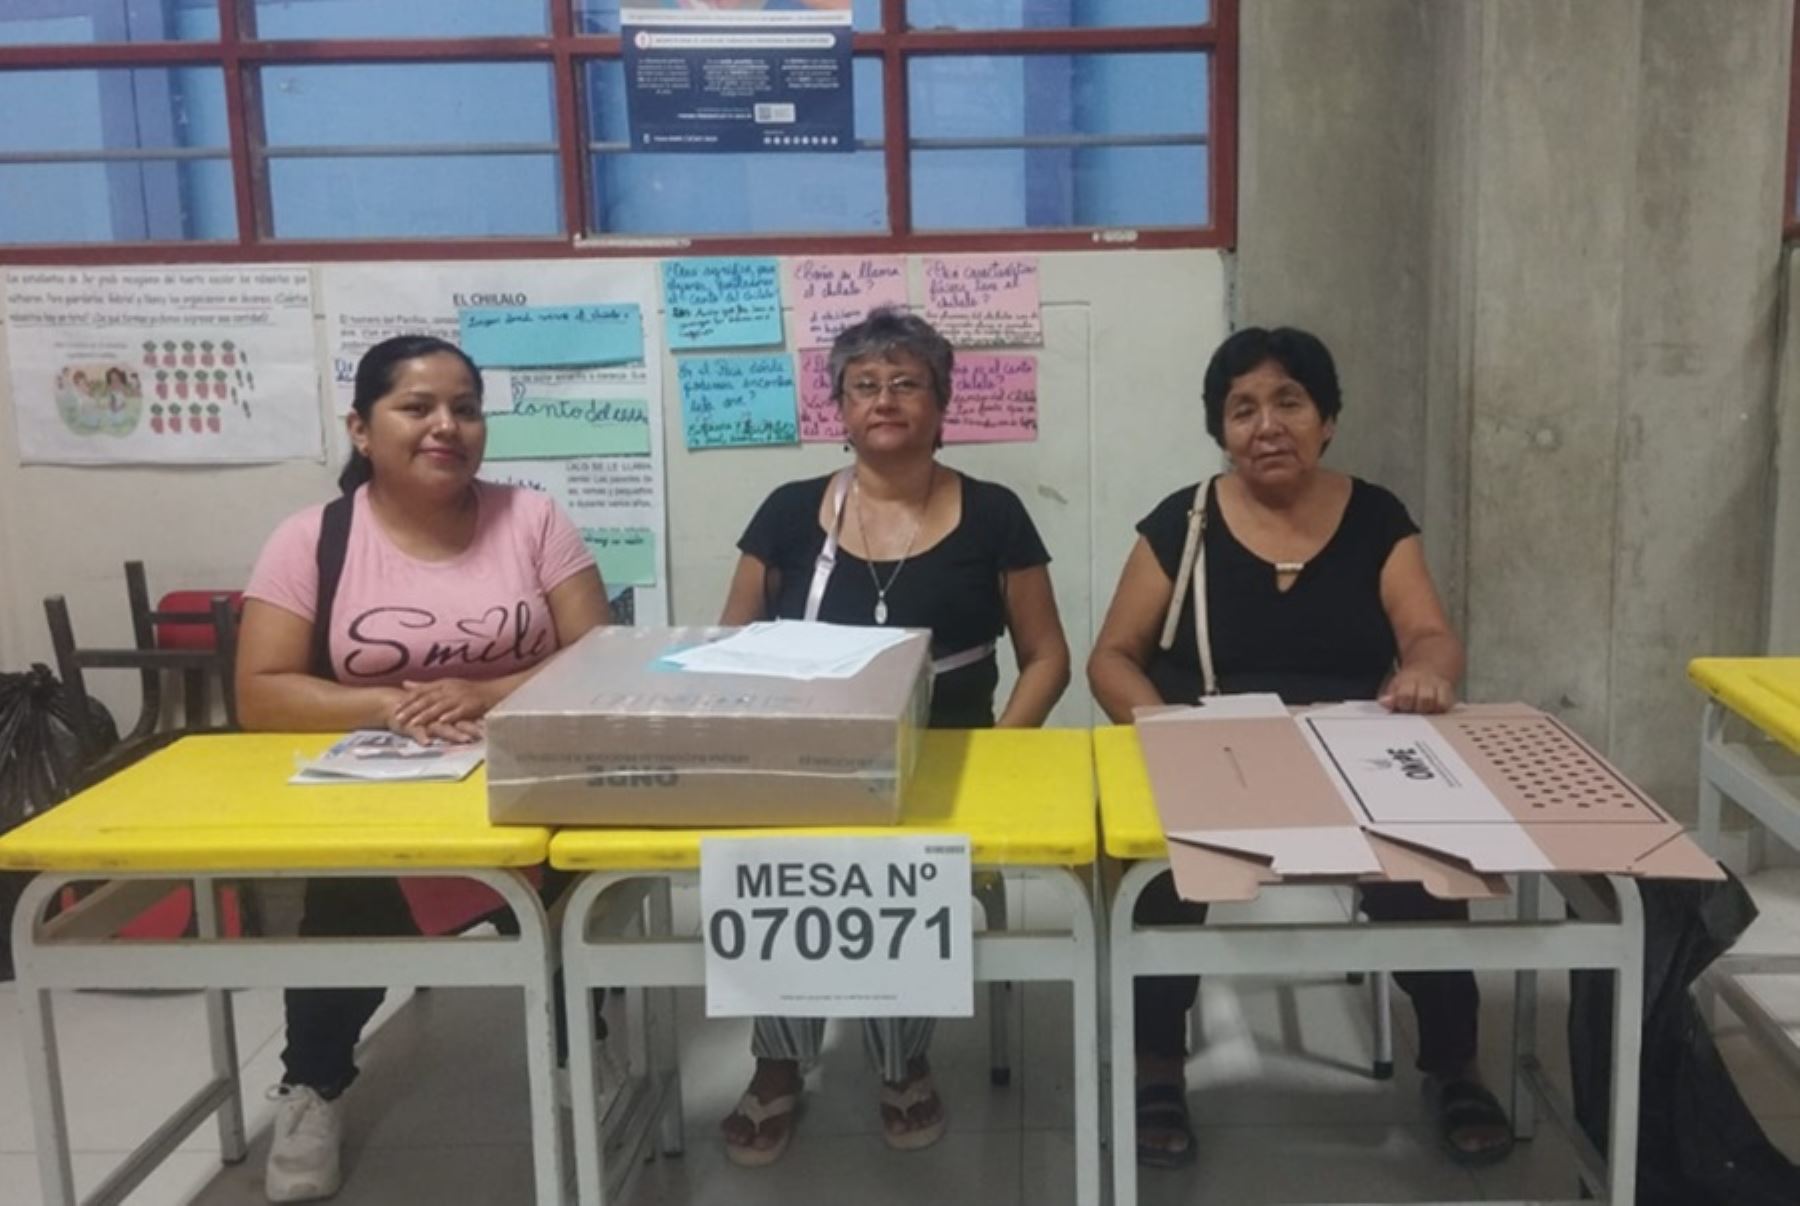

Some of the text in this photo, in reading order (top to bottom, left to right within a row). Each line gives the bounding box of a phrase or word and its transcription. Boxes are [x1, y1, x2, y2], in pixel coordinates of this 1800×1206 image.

[857, 260, 901, 280] llama
[453, 293, 527, 306] EL CHILALO
[565, 462, 590, 472] LALO
[586, 764, 679, 788] ONPE
[1385, 747, 1435, 781] ONPE
[736, 862, 938, 899] MESA Nº
[709, 905, 952, 961] 070971
